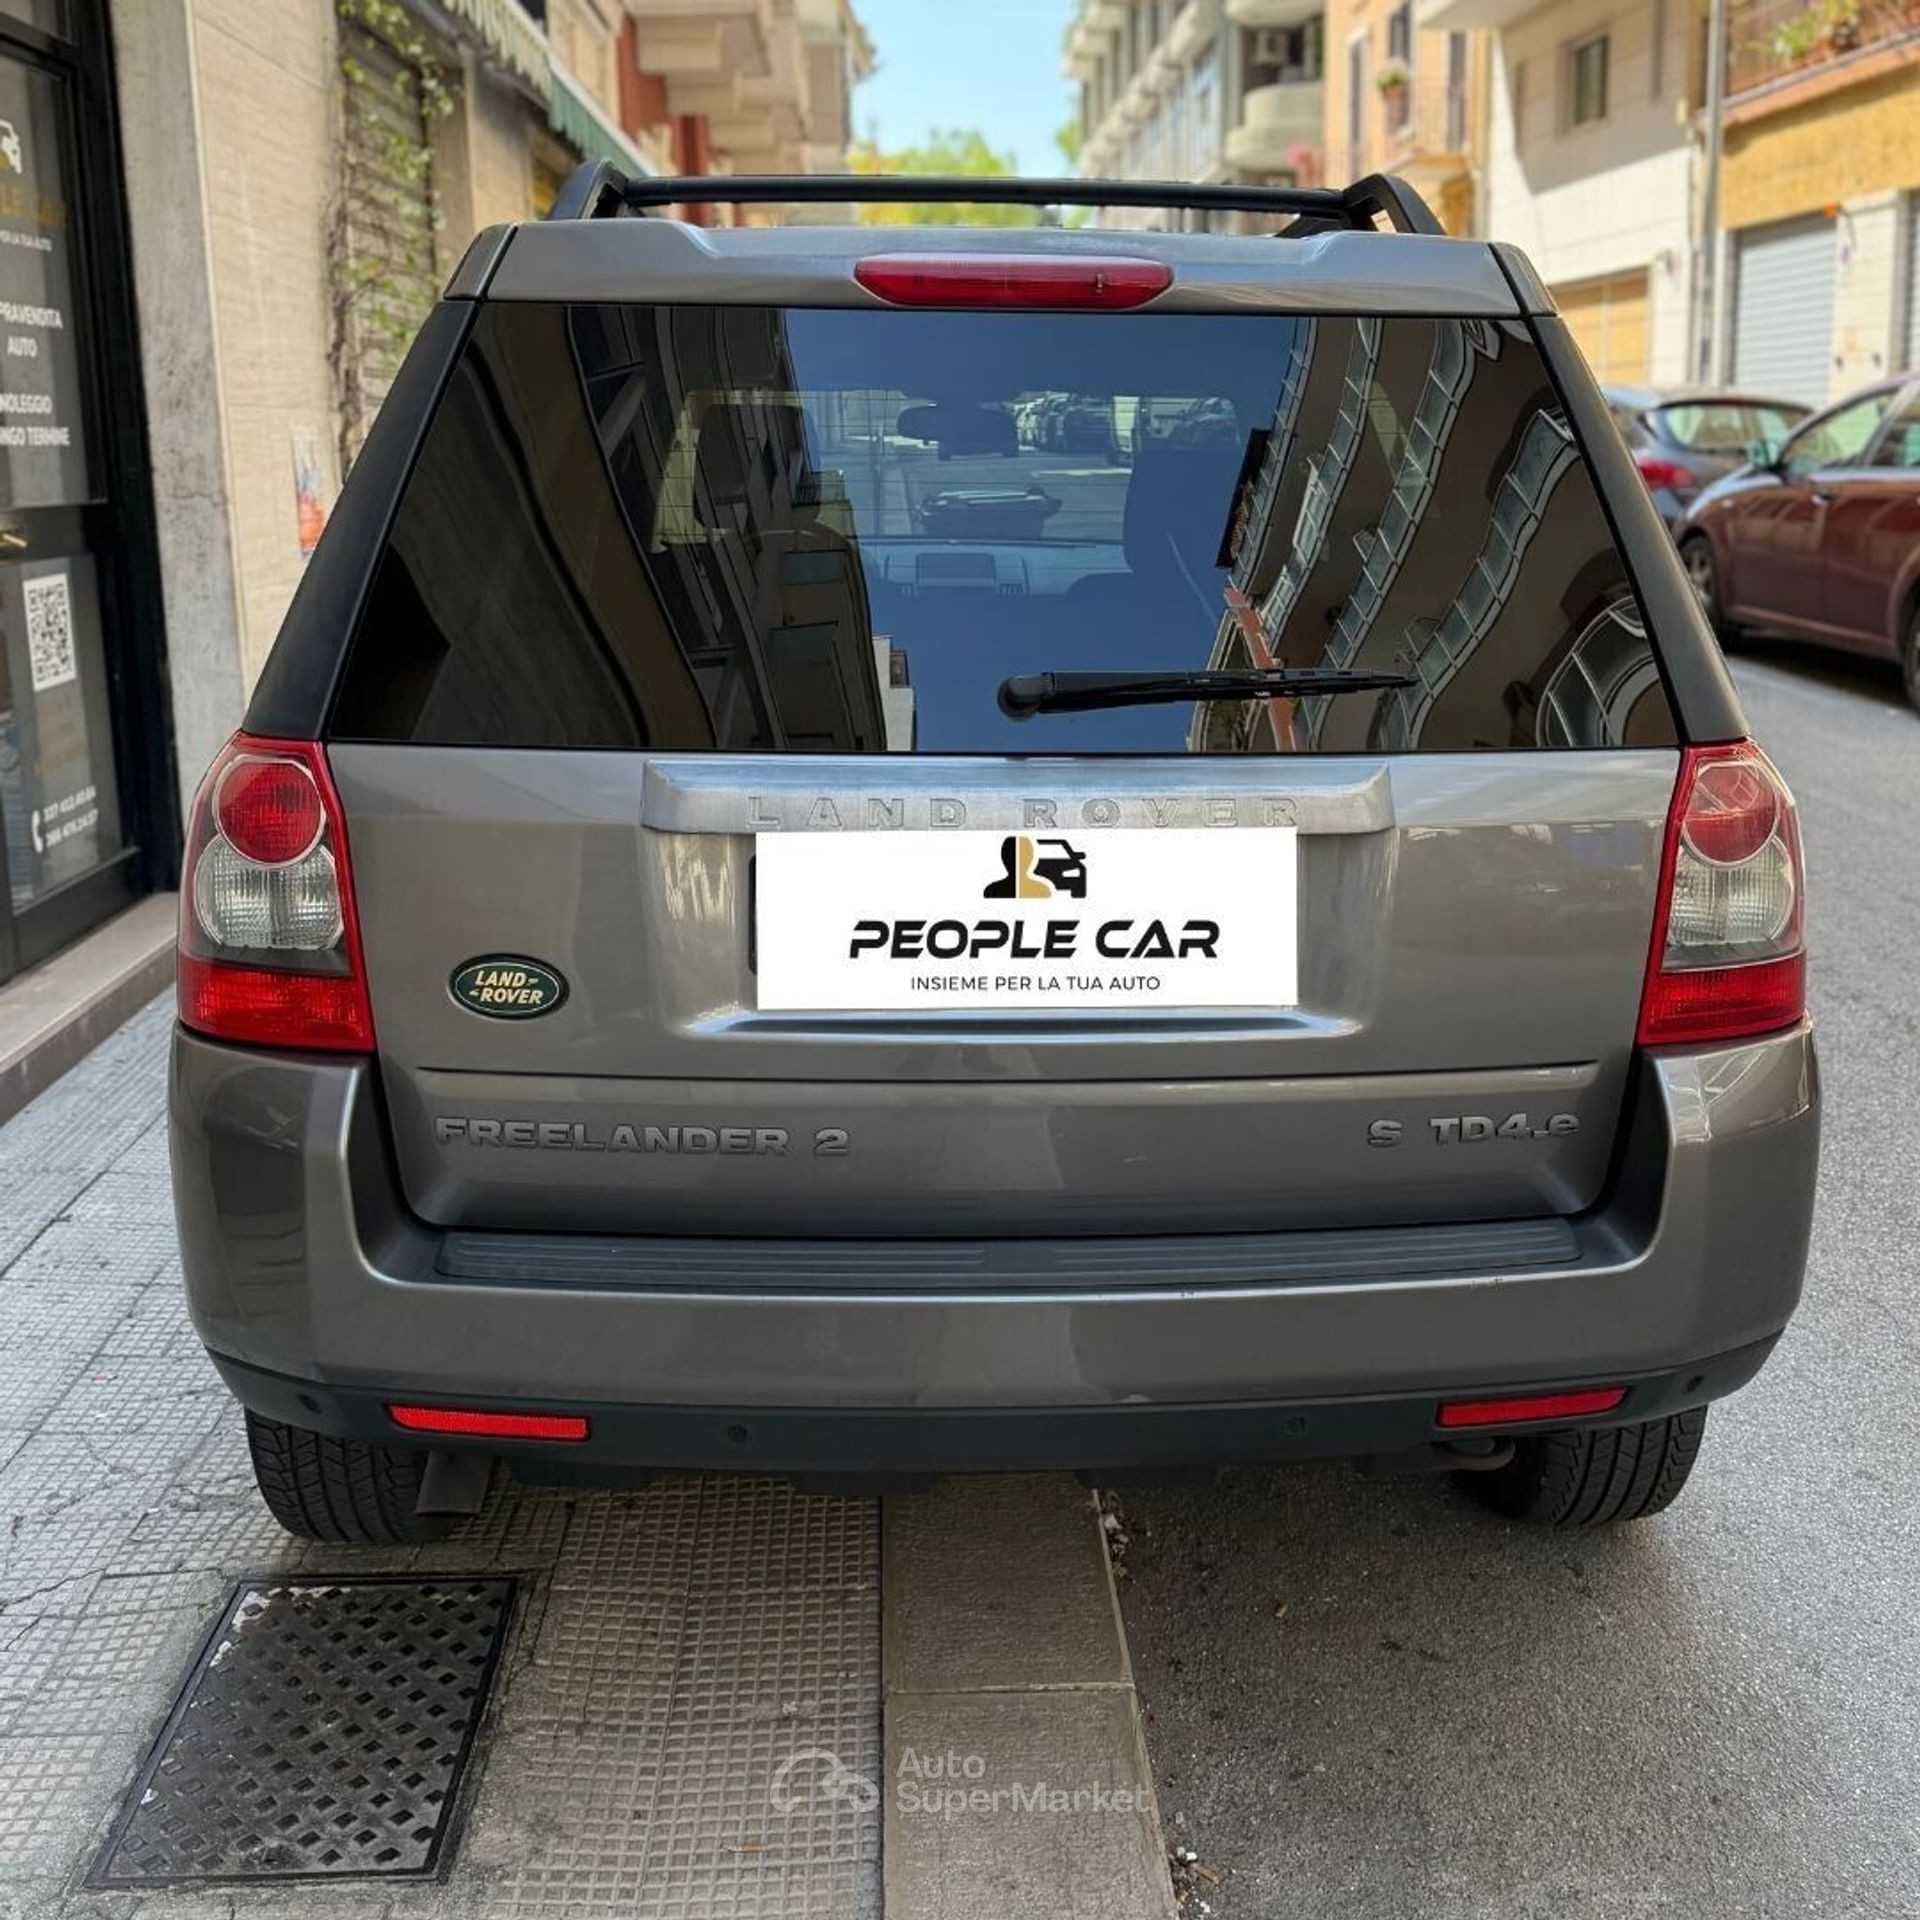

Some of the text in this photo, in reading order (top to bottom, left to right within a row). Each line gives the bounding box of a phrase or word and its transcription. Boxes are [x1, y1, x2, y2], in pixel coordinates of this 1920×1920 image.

[7, 336, 38, 357] AUTO
[27, 427, 70, 446] TERMINE
[747, 796, 1298, 829] LAND ROVER
[435, 1116, 850, 1156] FREELANDER 2
[1367, 1119, 1403, 1147] S
